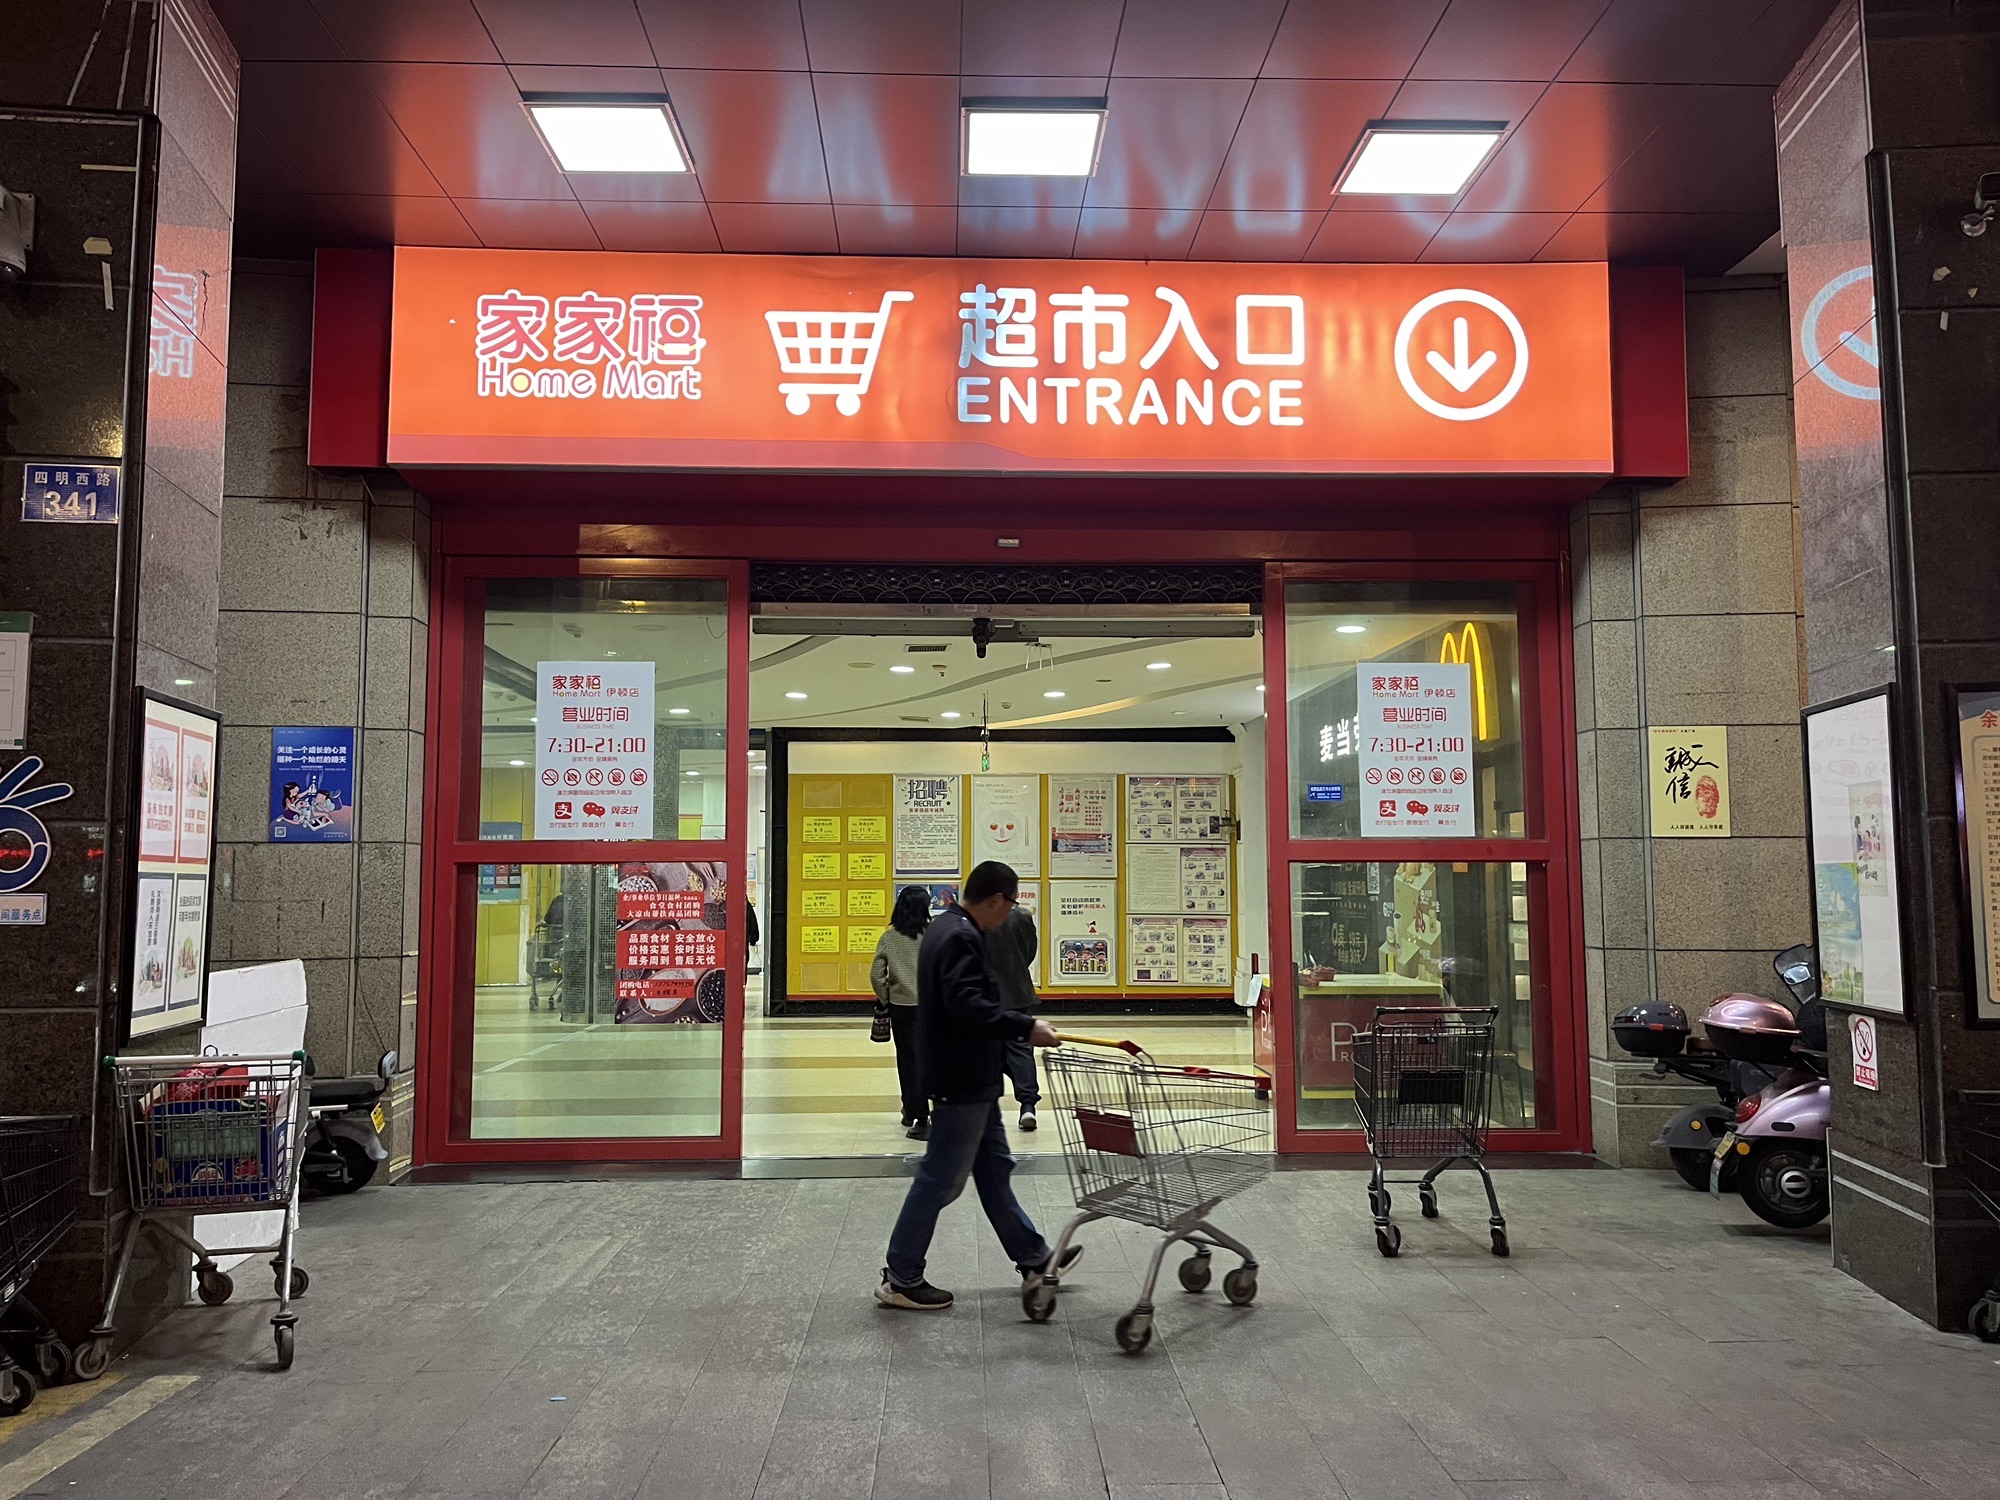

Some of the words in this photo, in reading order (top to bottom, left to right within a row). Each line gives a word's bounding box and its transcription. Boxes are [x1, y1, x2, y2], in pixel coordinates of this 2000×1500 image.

[476, 288, 706, 365] 家家福
[957, 283, 1304, 370] 超市入口
[478, 358, 597, 398] Home
[602, 362, 702, 400] Mart
[957, 375, 1304, 426] ENTRANCE
[34, 471, 110, 487] 四明西路
[45, 491, 98, 516] 341
[606, 688, 640, 697] 伊顿店
[1373, 690, 1397, 698] Home
[1424, 689, 1456, 698] 伊顿店
[562, 707, 629, 722] 营业时间
[1383, 707, 1447, 722] 营业时间
[277, 745, 347, 754] 关注一个成长的心灵
[547, 737, 646, 753] 7:30-21:00
[1369, 737, 1464, 752] 7:30-21:00
[277, 755, 347, 764] 播种一个灿烂的明天
[908, 779, 948, 799] 招聘
[649, 901, 701, 910] 食堂食材团购
[627, 909, 701, 918] 大凉山帮扶商品团购
[628, 933, 670, 943] 品质食材
[675, 933, 716, 943] 安全放心
[628, 944, 670, 954] 价格实惠
[674, 944, 716, 954] 按时送达
[628, 955, 670, 965] 服务周到
[674, 955, 716, 965] 售后无忧
